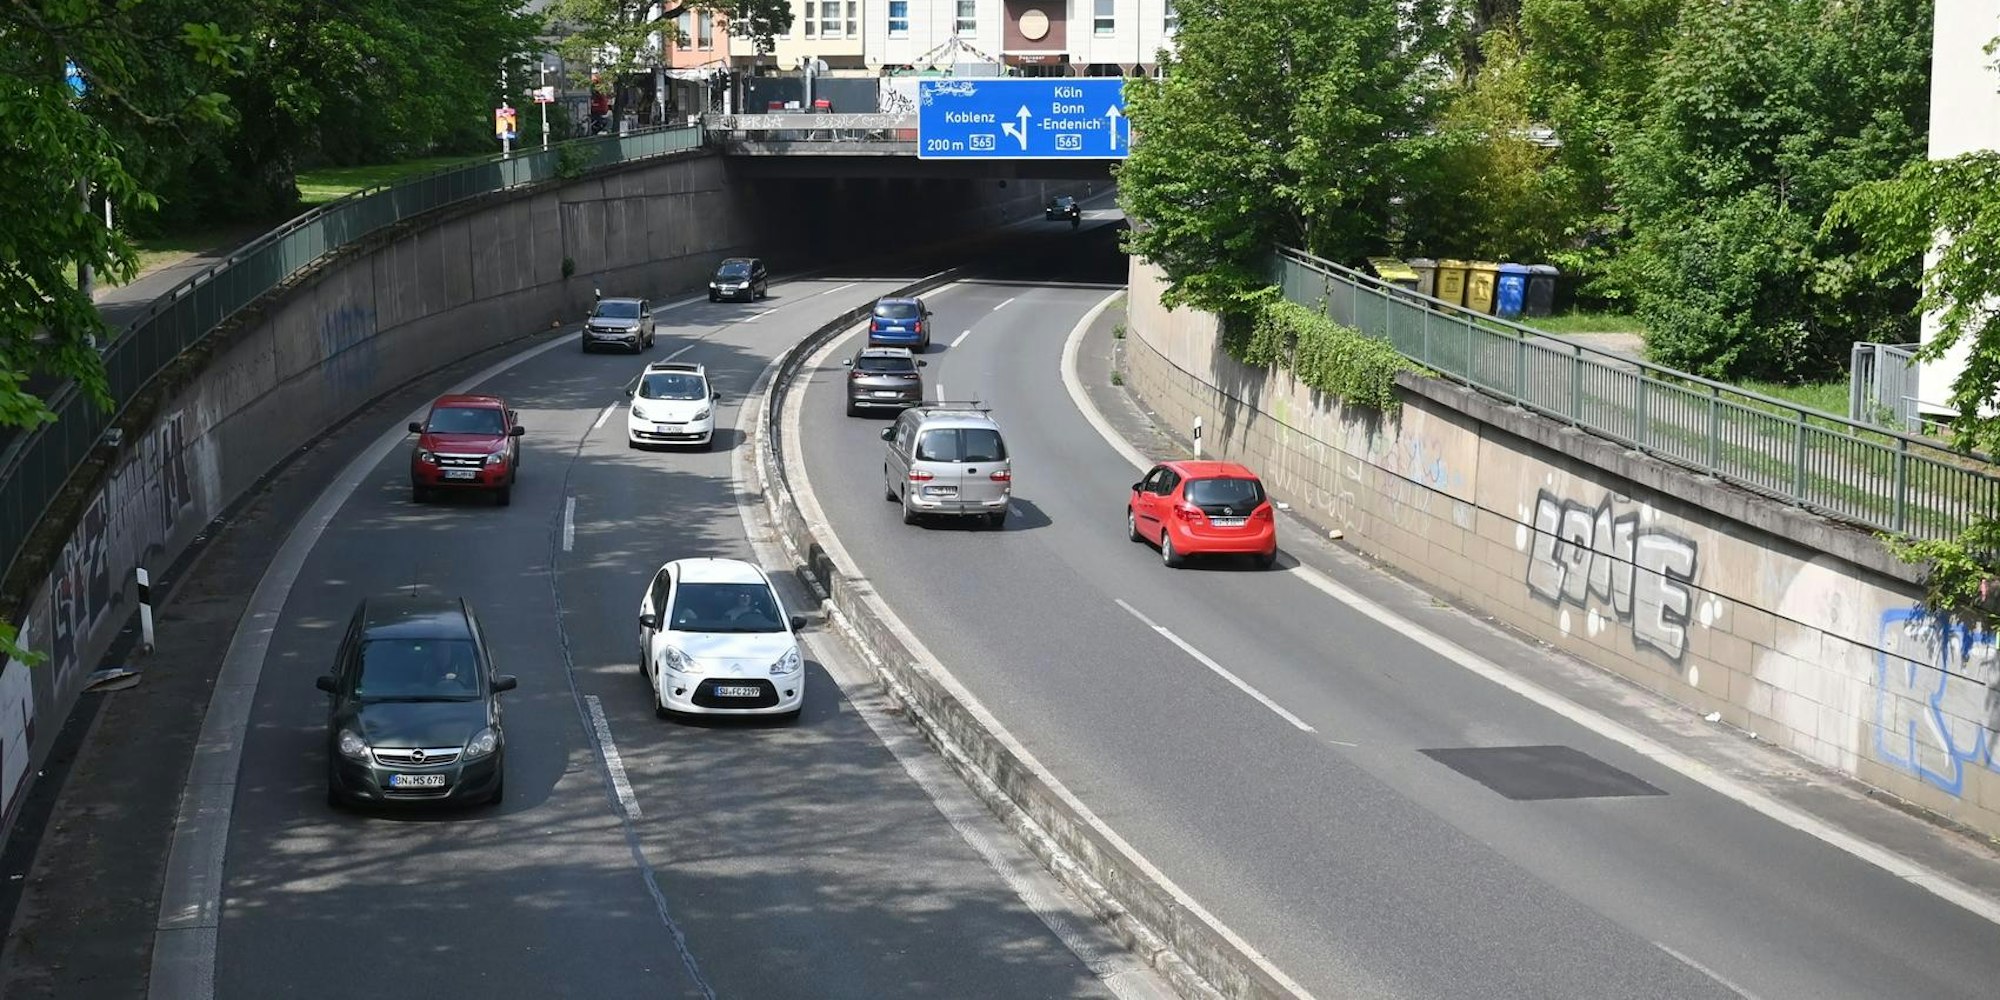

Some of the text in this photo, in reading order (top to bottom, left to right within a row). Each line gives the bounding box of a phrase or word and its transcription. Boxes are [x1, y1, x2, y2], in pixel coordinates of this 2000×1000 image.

[1054, 86, 1083, 98] Köln
[1052, 102, 1085, 114] Bonn
[945, 111, 996, 123] Koblenz
[1037, 118, 1101, 130] -Endenich
[927, 139, 964, 151] 200 m
[973, 137, 992, 147] 565
[1059, 137, 1078, 147] 565
